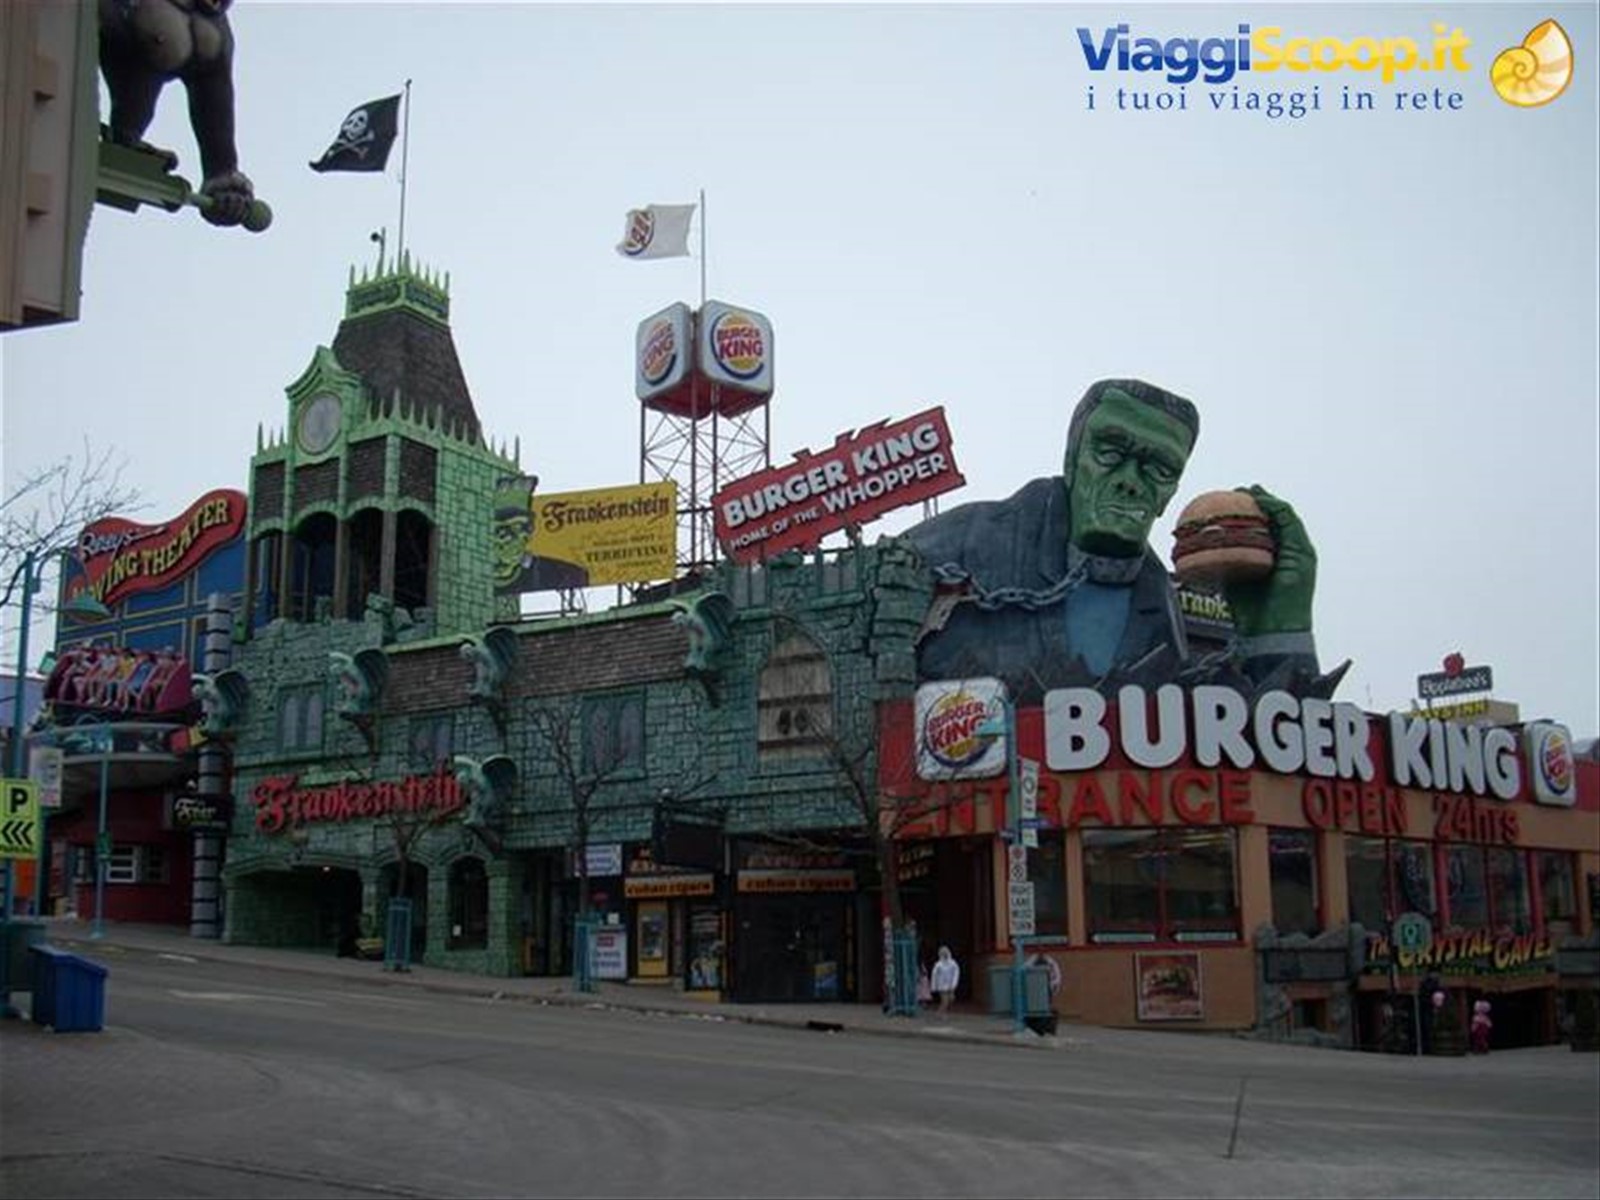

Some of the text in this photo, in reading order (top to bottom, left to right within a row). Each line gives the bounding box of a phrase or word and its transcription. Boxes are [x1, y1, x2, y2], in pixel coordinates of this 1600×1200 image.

[719, 338, 764, 360] KING
[722, 422, 941, 528] BURGER KING
[730, 451, 949, 550] HOME OF THE WHOPPER
[139, 498, 231, 576] THEATER
[541, 491, 672, 533] Frankenstein
[584, 545, 671, 564] TERRIFYING
[1180, 591, 1233, 620] rank
[928, 702, 985, 734] BURGER
[1043, 684, 1520, 799] BURGER KING
[892, 770, 1254, 838] ENTRANCE
[1303, 780, 1408, 834] OPEN
